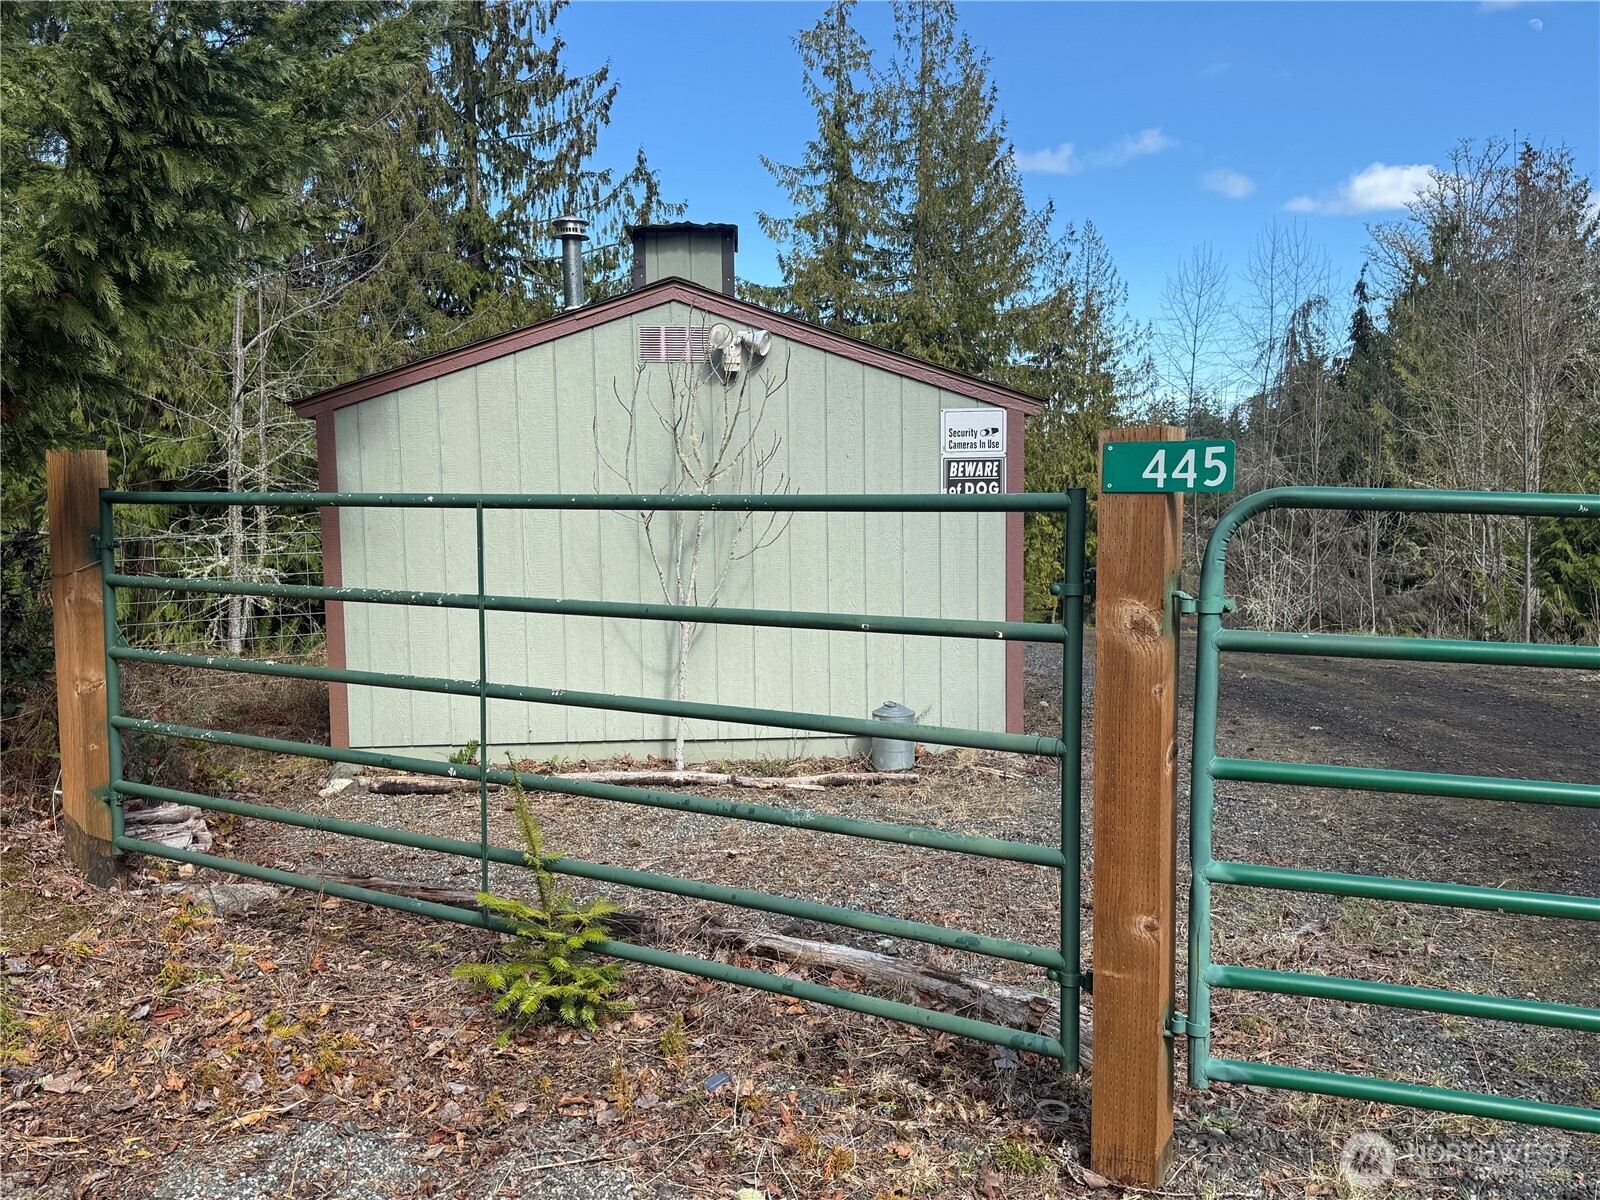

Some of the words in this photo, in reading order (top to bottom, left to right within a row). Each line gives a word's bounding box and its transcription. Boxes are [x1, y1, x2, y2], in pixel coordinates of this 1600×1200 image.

[948, 427, 978, 439] Security
[948, 440, 978, 450] Cameras
[979, 439, 986, 449] In
[987, 439, 1000, 449] Use
[949, 461, 999, 477] BEWARE
[1142, 446, 1227, 488] 445
[948, 482, 962, 494] of
[964, 481, 1000, 494] DOG
